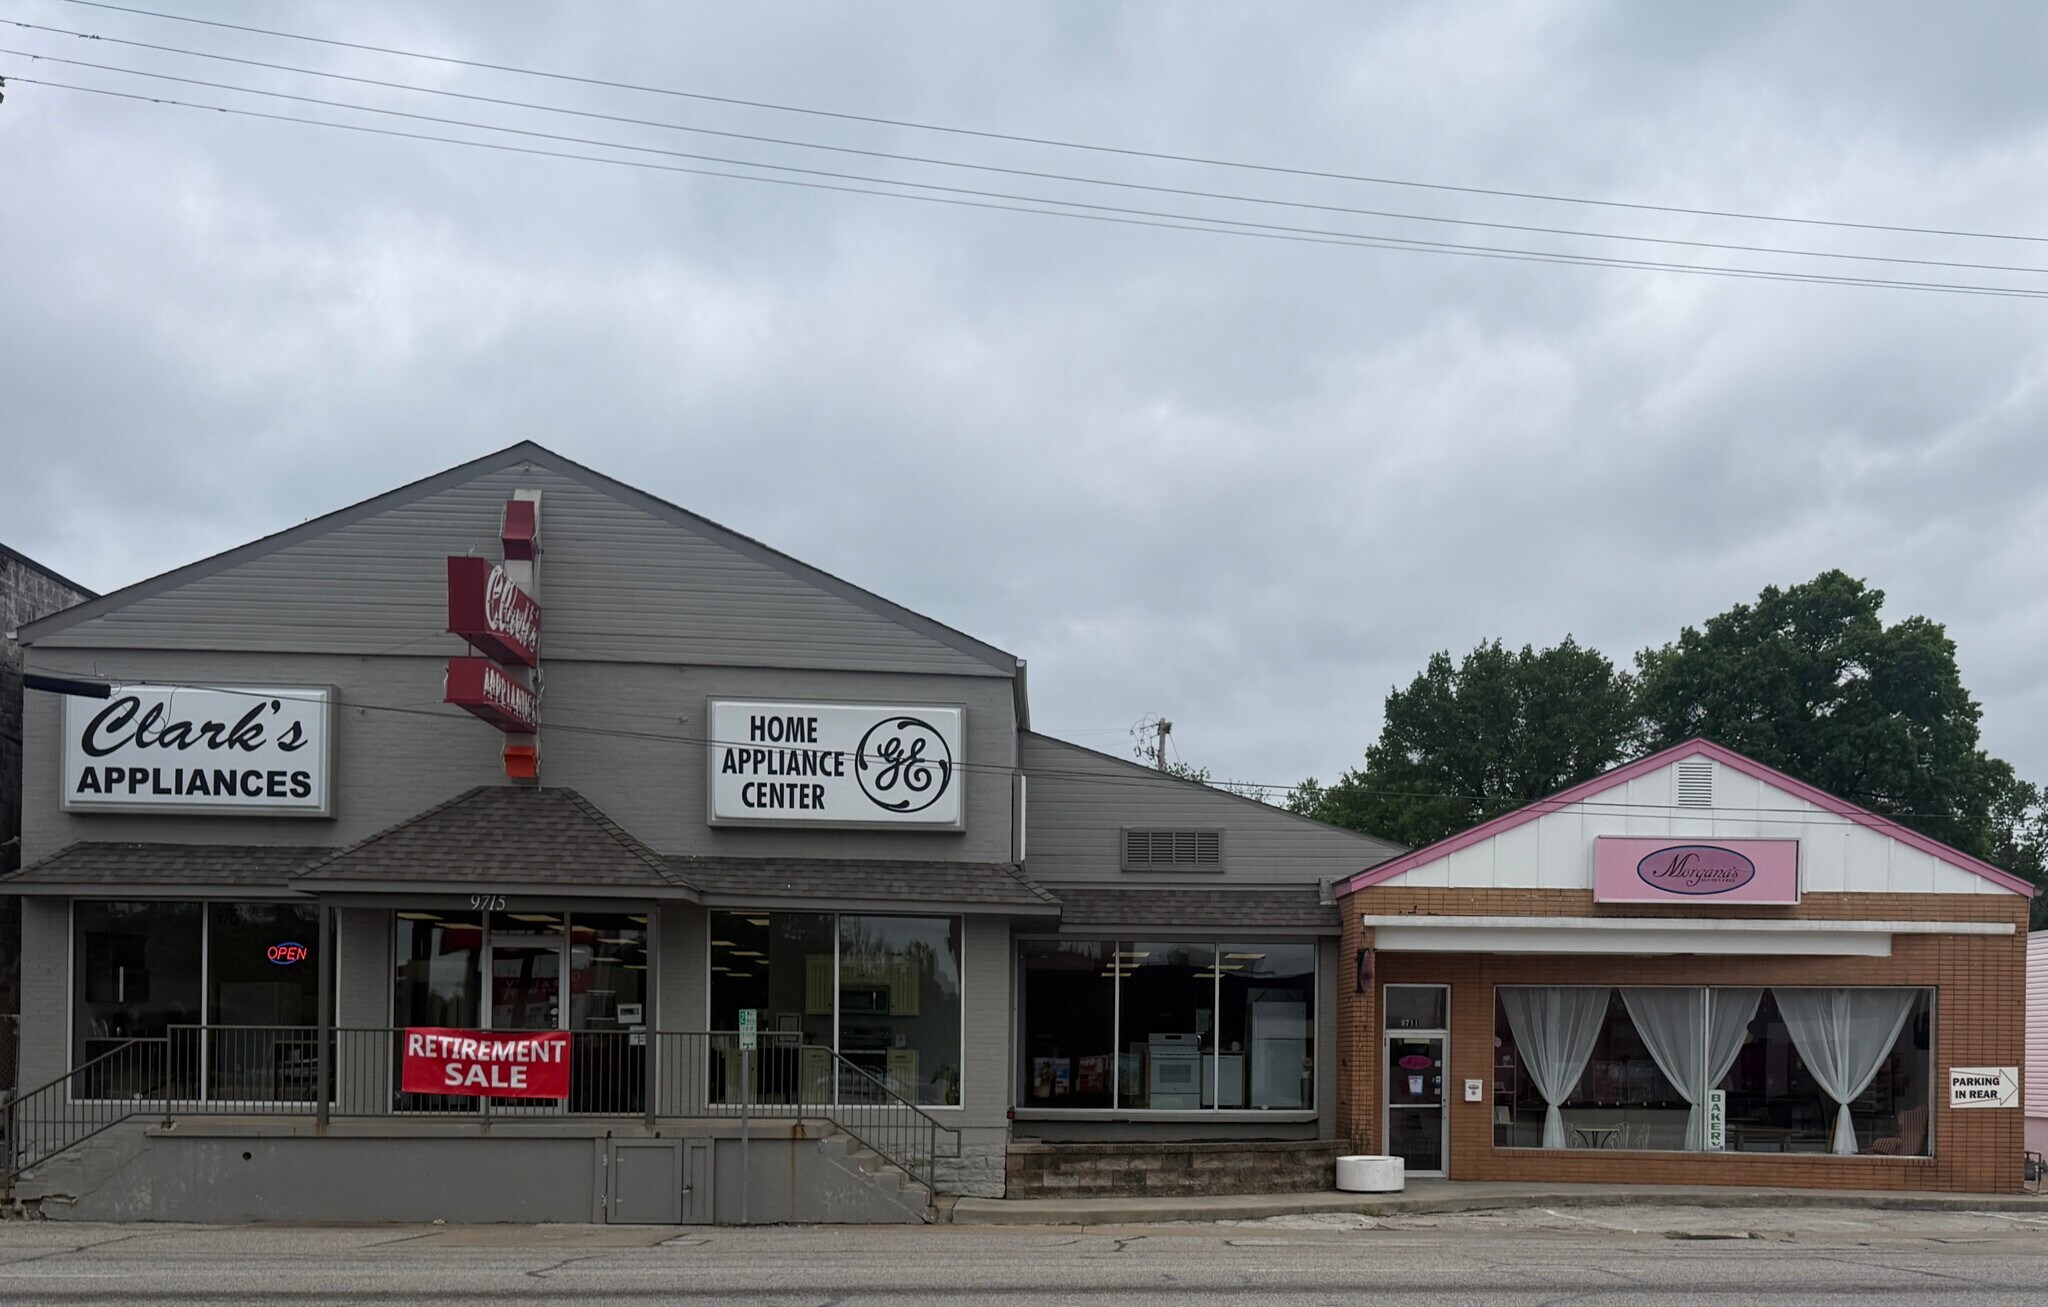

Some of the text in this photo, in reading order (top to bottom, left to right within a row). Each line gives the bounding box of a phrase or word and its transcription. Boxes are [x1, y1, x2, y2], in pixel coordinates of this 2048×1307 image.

[81, 696, 309, 757] Clark's
[750, 716, 818, 743] HOME
[722, 748, 845, 777] APPLIANCE
[76, 766, 312, 798] APPLIANCES
[741, 782, 825, 810] CENTER
[1652, 853, 1740, 887] Morgana's
[471, 894, 507, 911] 9715
[267, 946, 307, 960] OPEN
[408, 1033, 566, 1063] RETIREMENT
[444, 1062, 528, 1089] SALE
[1952, 1077, 2000, 1087] PARKING
[1955, 1090, 1998, 1099] IN REAR
